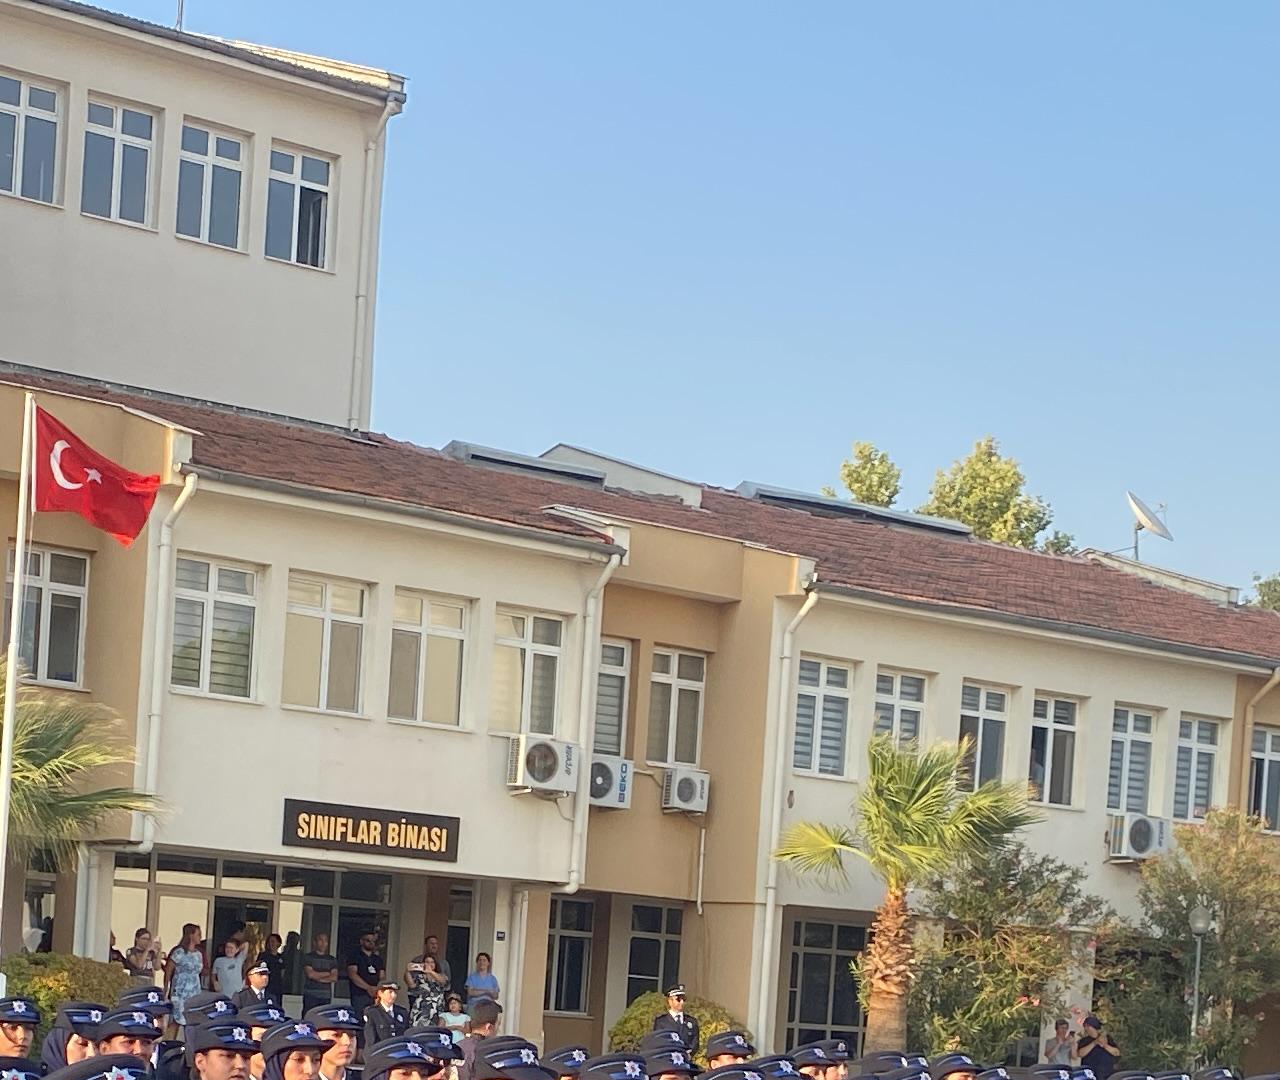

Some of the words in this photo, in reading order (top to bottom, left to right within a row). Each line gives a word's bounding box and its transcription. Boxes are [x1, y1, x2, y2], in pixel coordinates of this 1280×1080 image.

[618, 763, 628, 803] BEKO
[297, 812, 382, 846] SINIFLAR
[387, 817, 447, 852] BİNASI
